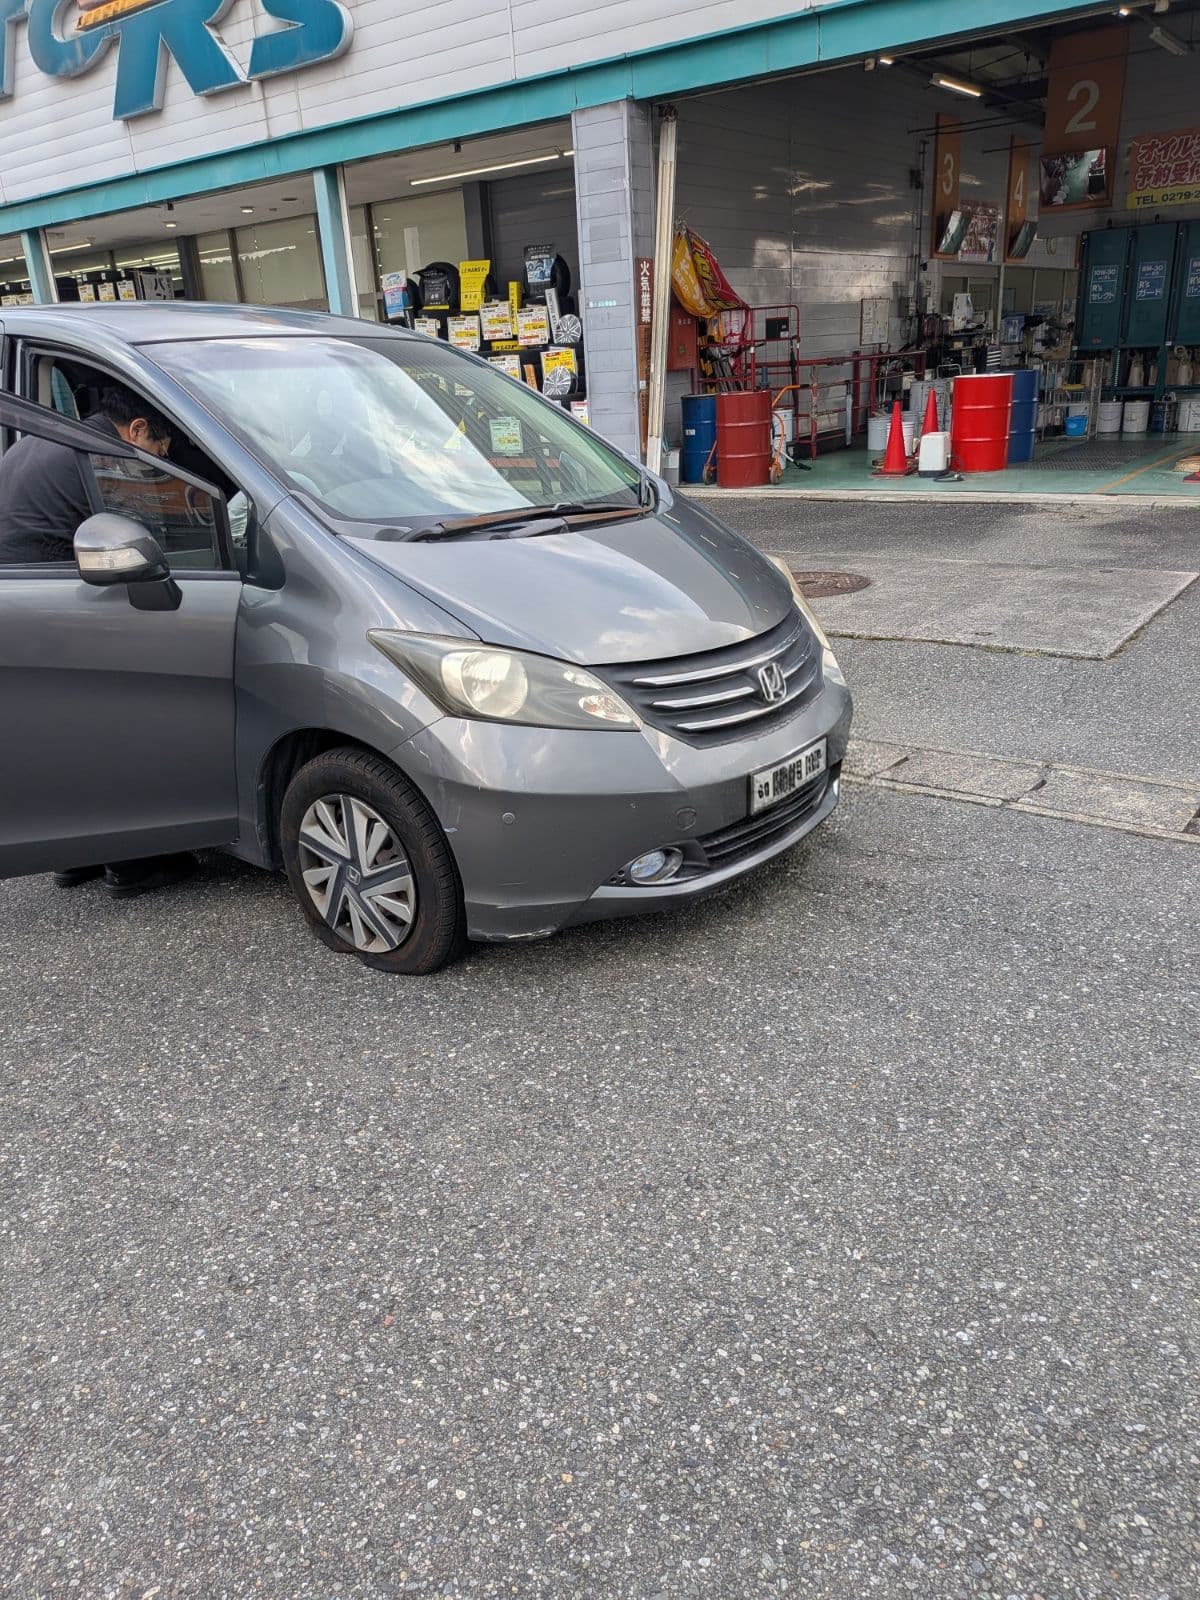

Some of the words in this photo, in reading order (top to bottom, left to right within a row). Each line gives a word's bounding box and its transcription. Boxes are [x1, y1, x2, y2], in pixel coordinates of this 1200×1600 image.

[1065, 79, 1099, 134] 2
[943, 153, 954, 195] 3
[1014, 170, 1024, 208] 4
[1135, 194, 1158, 205] TEL
[640, 260, 651, 324] 火気厳禁
